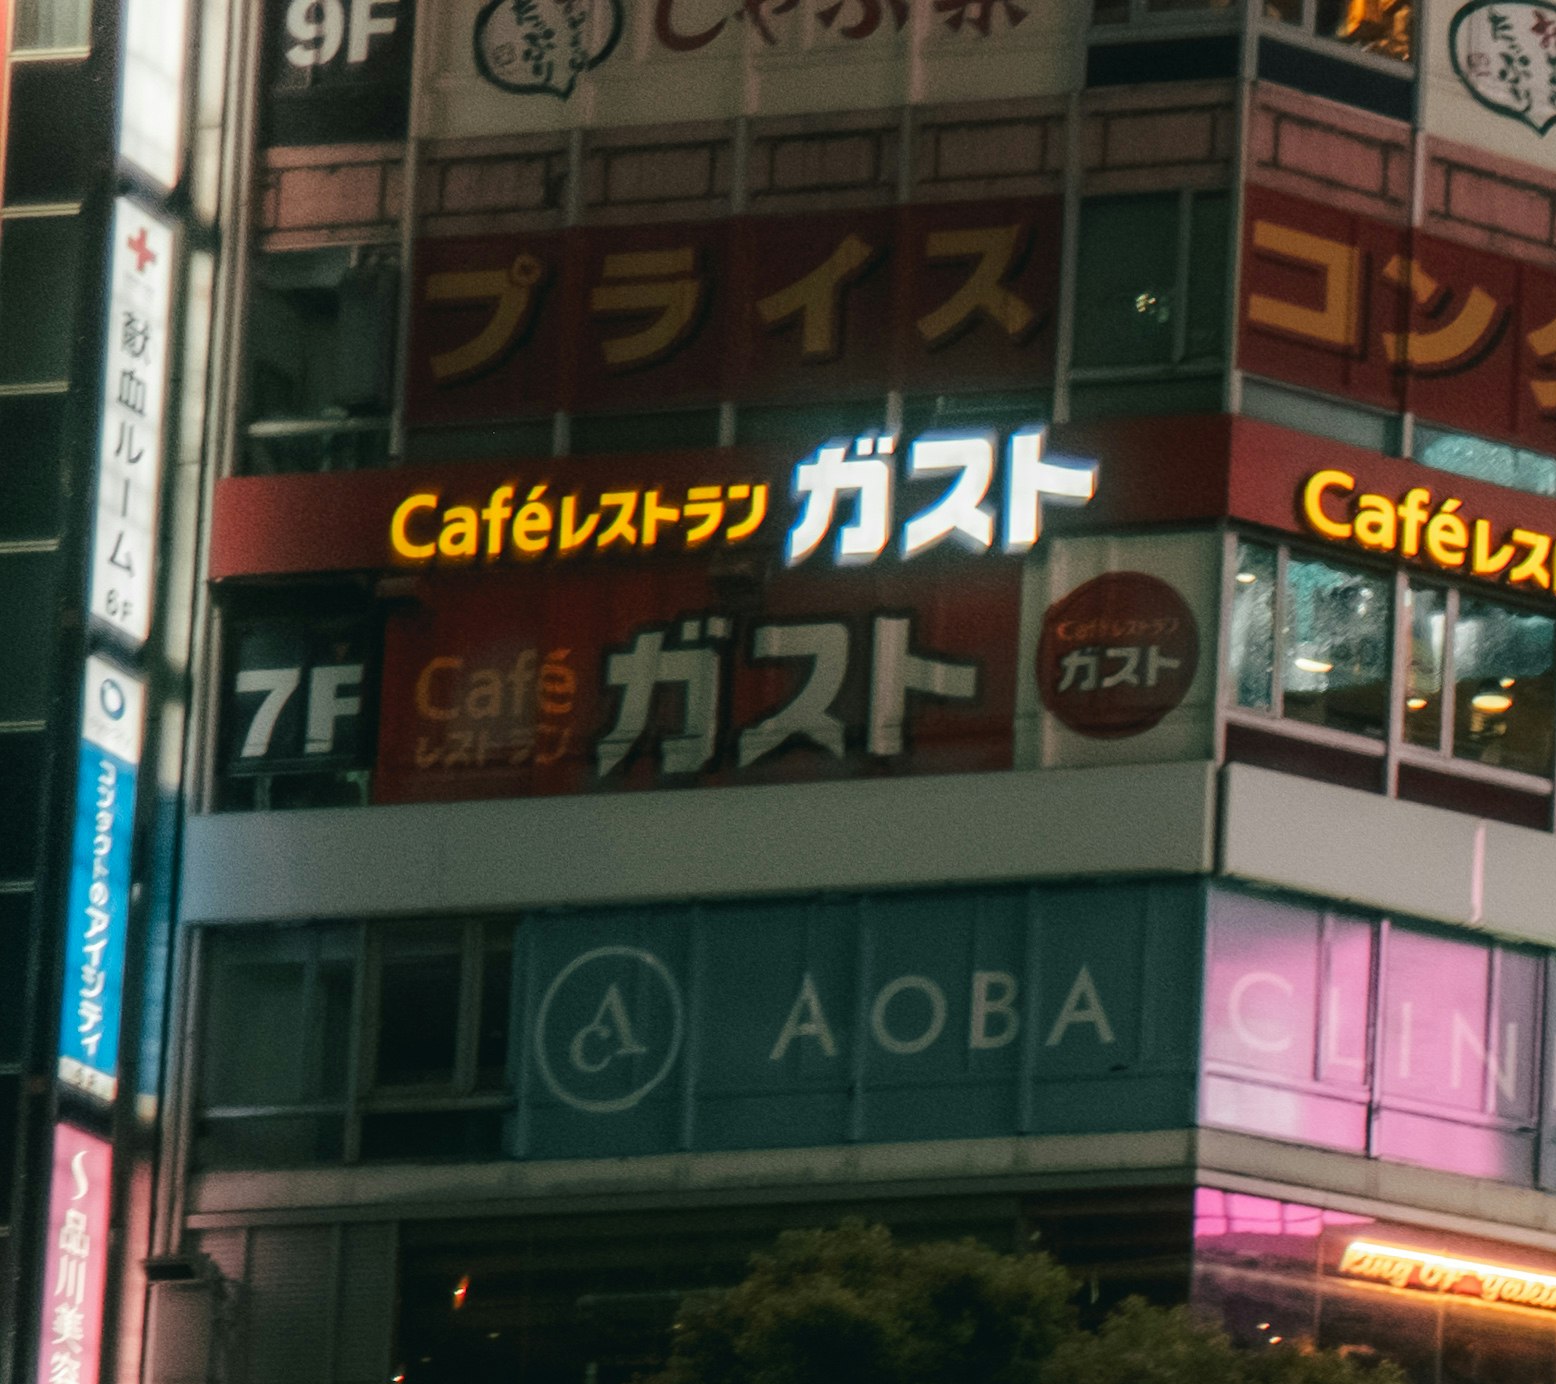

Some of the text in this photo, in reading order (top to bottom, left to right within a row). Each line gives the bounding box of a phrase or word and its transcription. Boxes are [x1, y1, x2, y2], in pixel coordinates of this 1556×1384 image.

[285, 0, 398, 66] 9F
[422, 222, 1048, 381] プライス
[392, 426, 1099, 567] Caféレストラン ガスト
[234, 663, 366, 758] 7F
[412, 648, 577, 722] Café
[598, 613, 977, 781] ガスト
[1057, 645, 1184, 694] ガスト
[770, 965, 1115, 1061] AOBA
